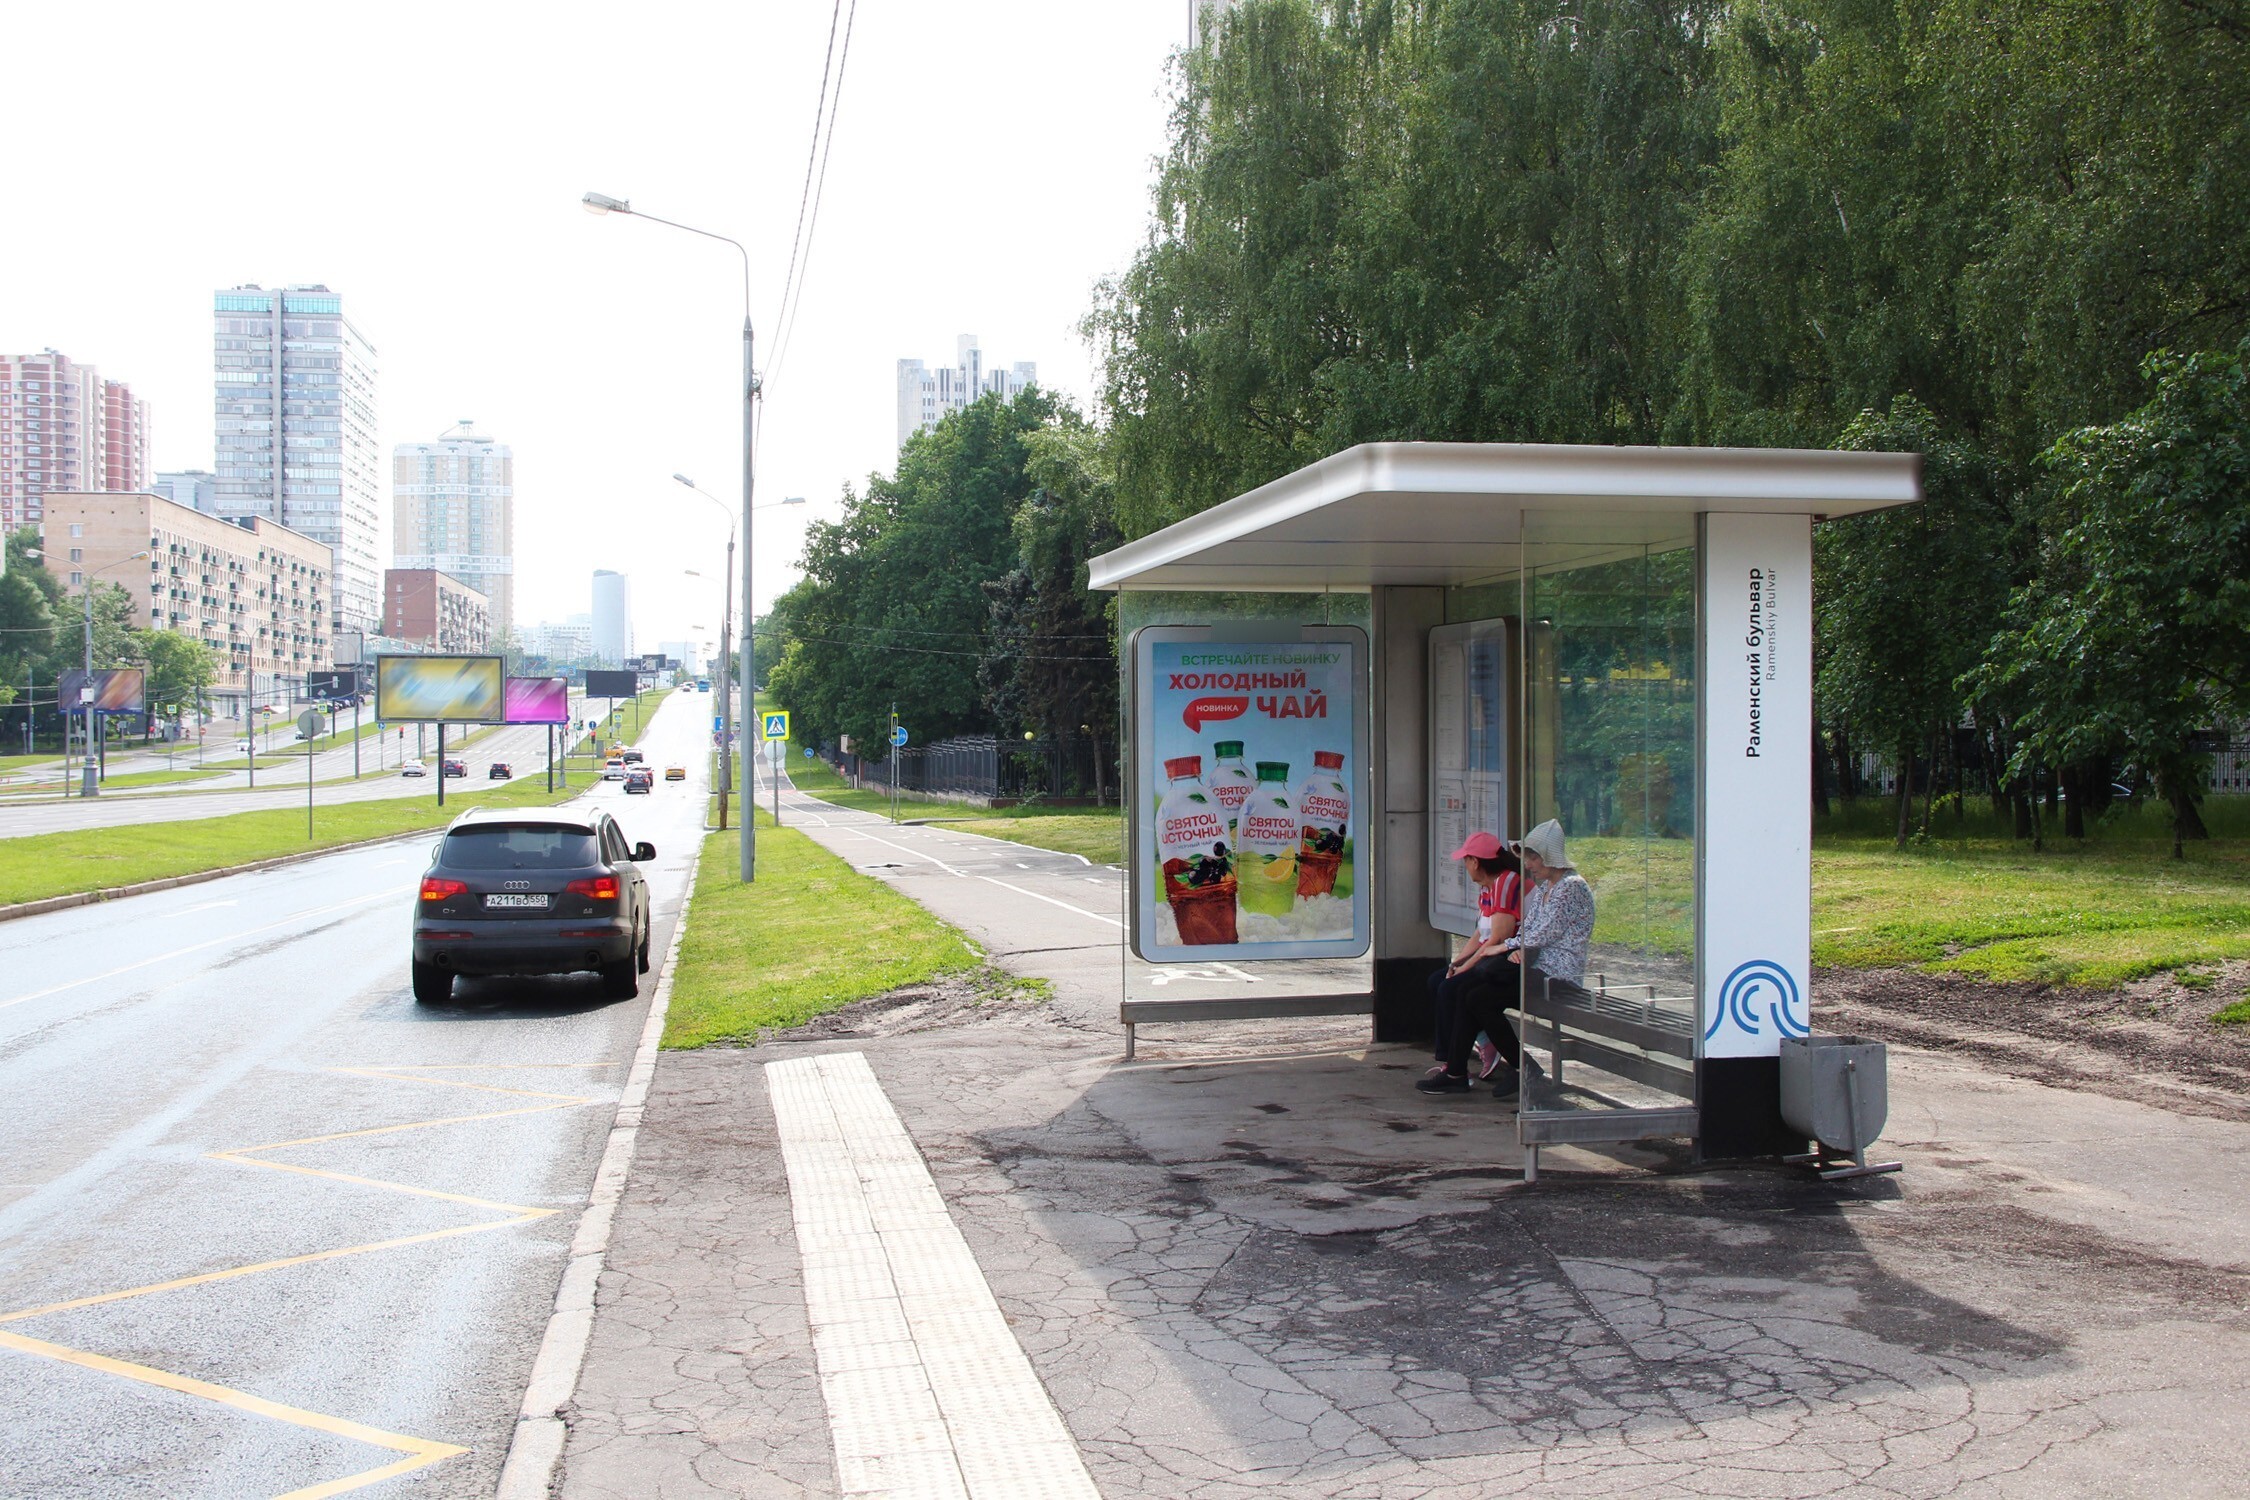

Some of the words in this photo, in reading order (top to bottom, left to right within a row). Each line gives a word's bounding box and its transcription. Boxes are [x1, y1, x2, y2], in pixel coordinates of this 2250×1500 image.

[1765, 568, 1776, 608] Bulvar
[1746, 568, 1764, 647] бульвар
[1181, 652, 1269, 666] ВСТРЕЧАЙТЕ
[1272, 653, 1341, 665] НОВИНКУ
[1765, 612, 1778, 680] Ramenskiy
[1168, 668, 1306, 691] ХОЛОДНЫЙ
[1196, 704, 1239, 713] НОВИНКА
[1256, 688, 1327, 719] ЧАЙ
[1746, 653, 1761, 757] Раменский
[1161, 825, 1225, 844] ИСТОЧНИК
[1242, 827, 1298, 840] ИСТОЧНИК
